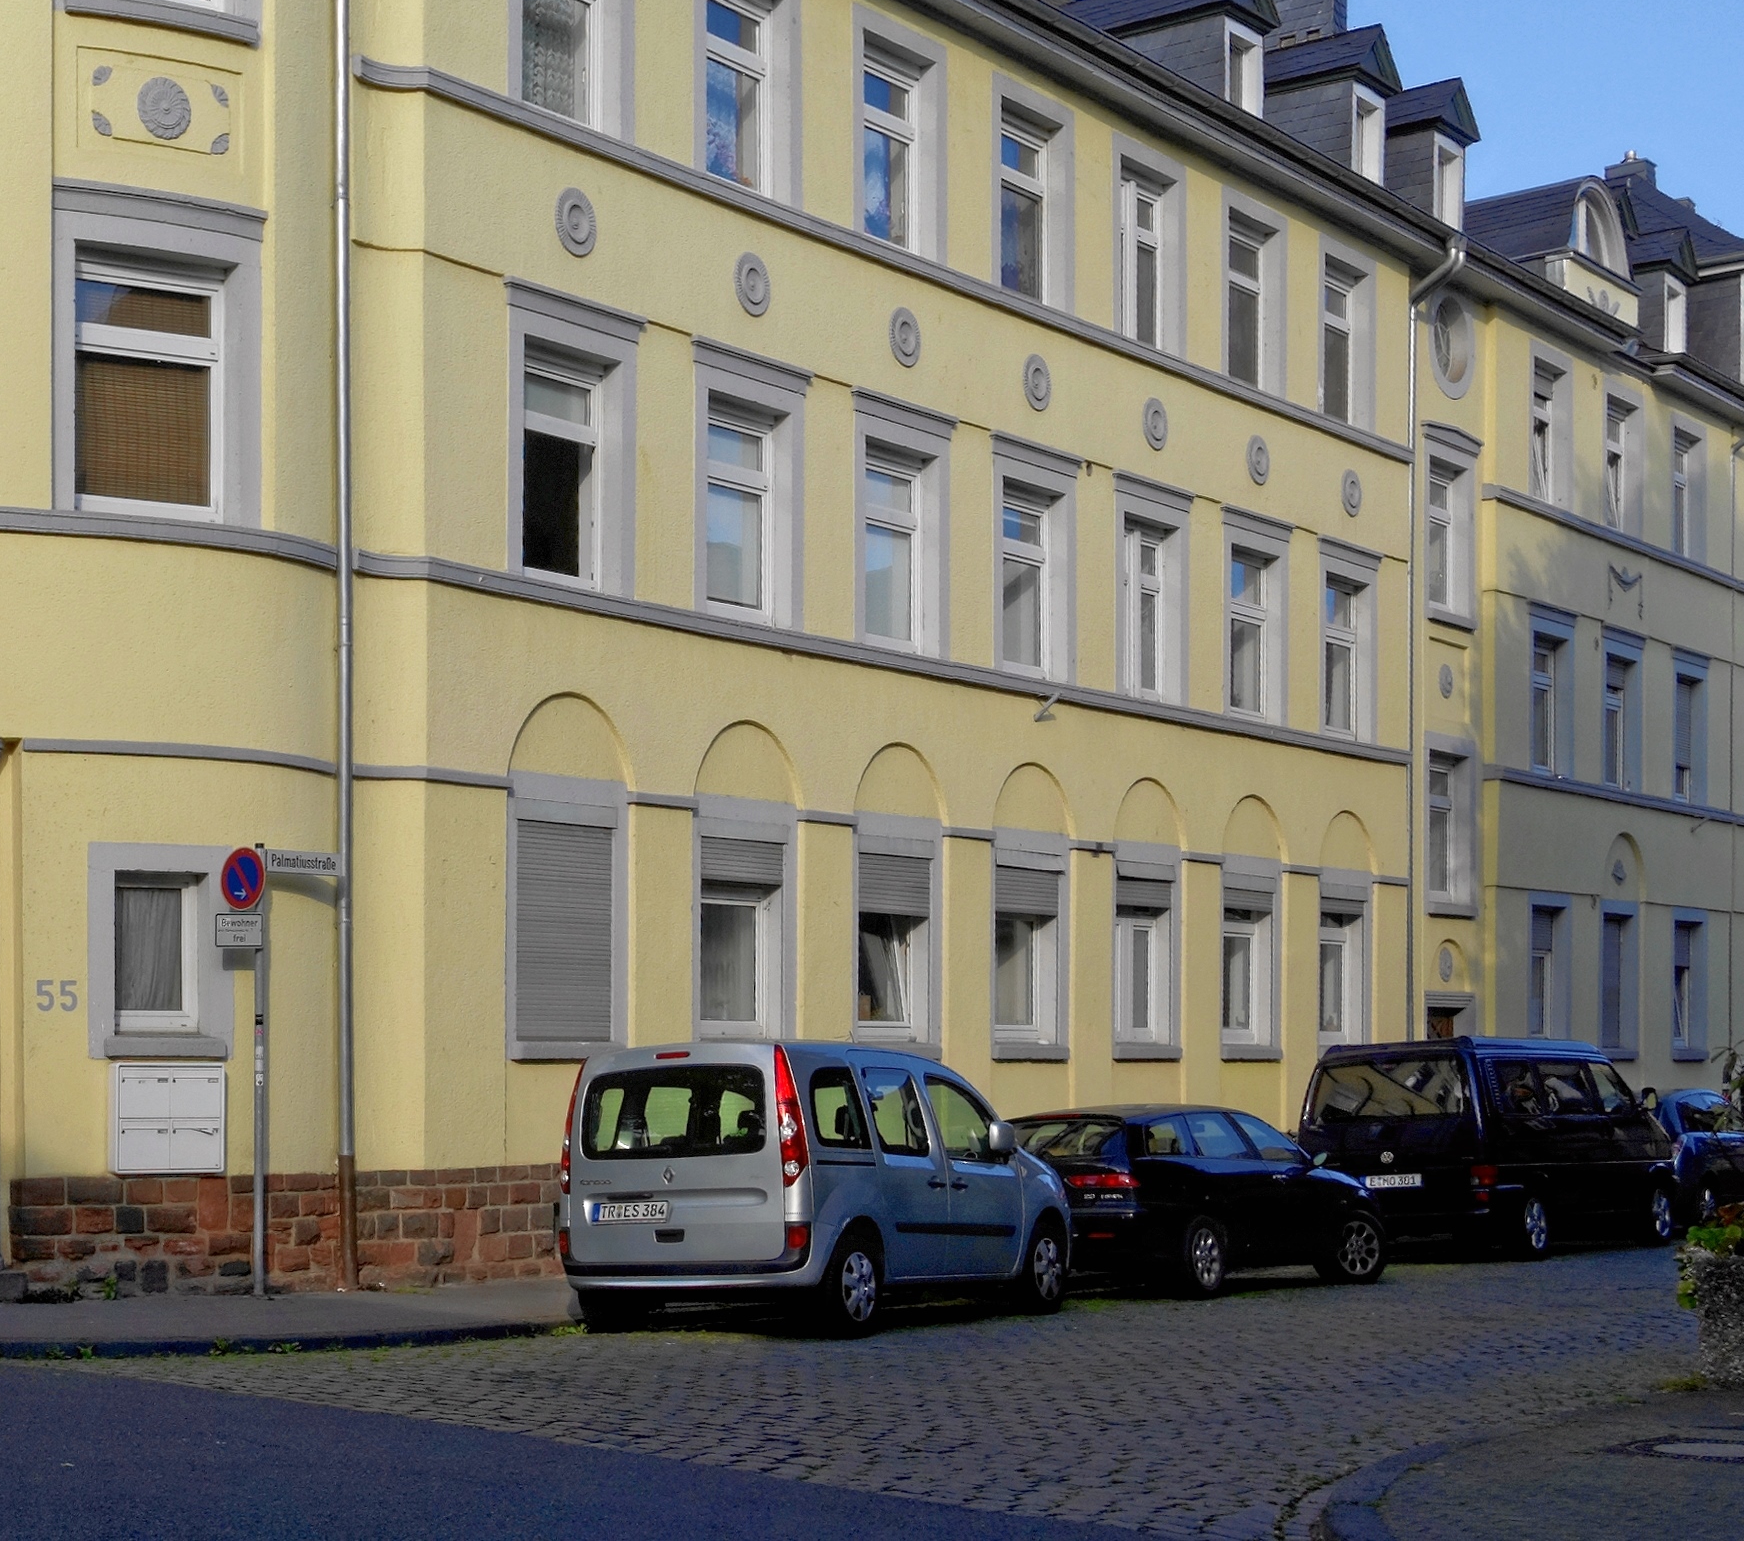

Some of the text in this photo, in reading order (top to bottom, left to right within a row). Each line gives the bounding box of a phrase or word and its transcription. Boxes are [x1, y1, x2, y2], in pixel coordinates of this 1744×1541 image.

[271, 853, 337, 871] Palmatiusstraße
[221, 918, 259, 928] Bewohner
[233, 933, 247, 943] frei
[36, 979, 79, 1012] 55
[601, 1203, 666, 1219] TR ES 384
